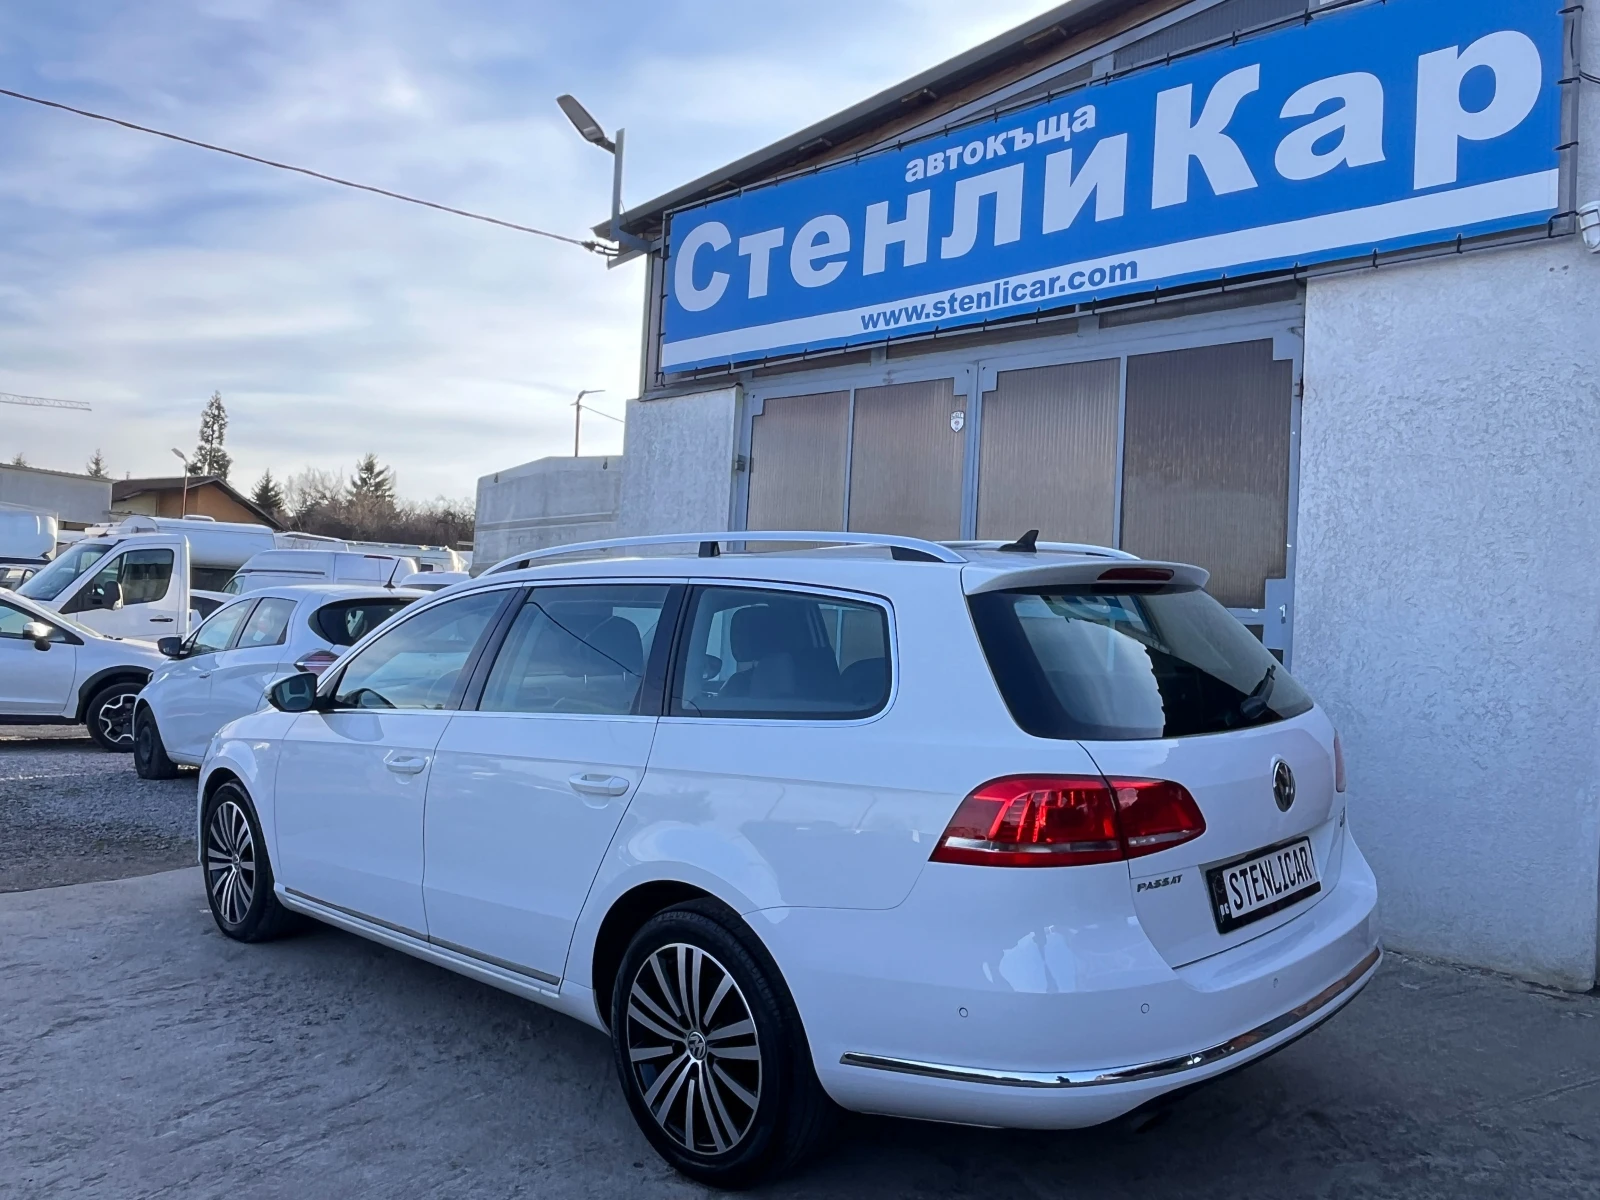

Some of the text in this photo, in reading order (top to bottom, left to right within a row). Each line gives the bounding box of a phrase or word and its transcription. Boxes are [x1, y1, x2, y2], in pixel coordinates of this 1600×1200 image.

[673, 30, 1542, 312] СтенлиКар
[904, 104, 1096, 183] автокъща
[861, 260, 1138, 330] www.stenlicar.com
[1136, 874, 1183, 893] PASSAT
[1229, 847, 1312, 911] STENLICAR
